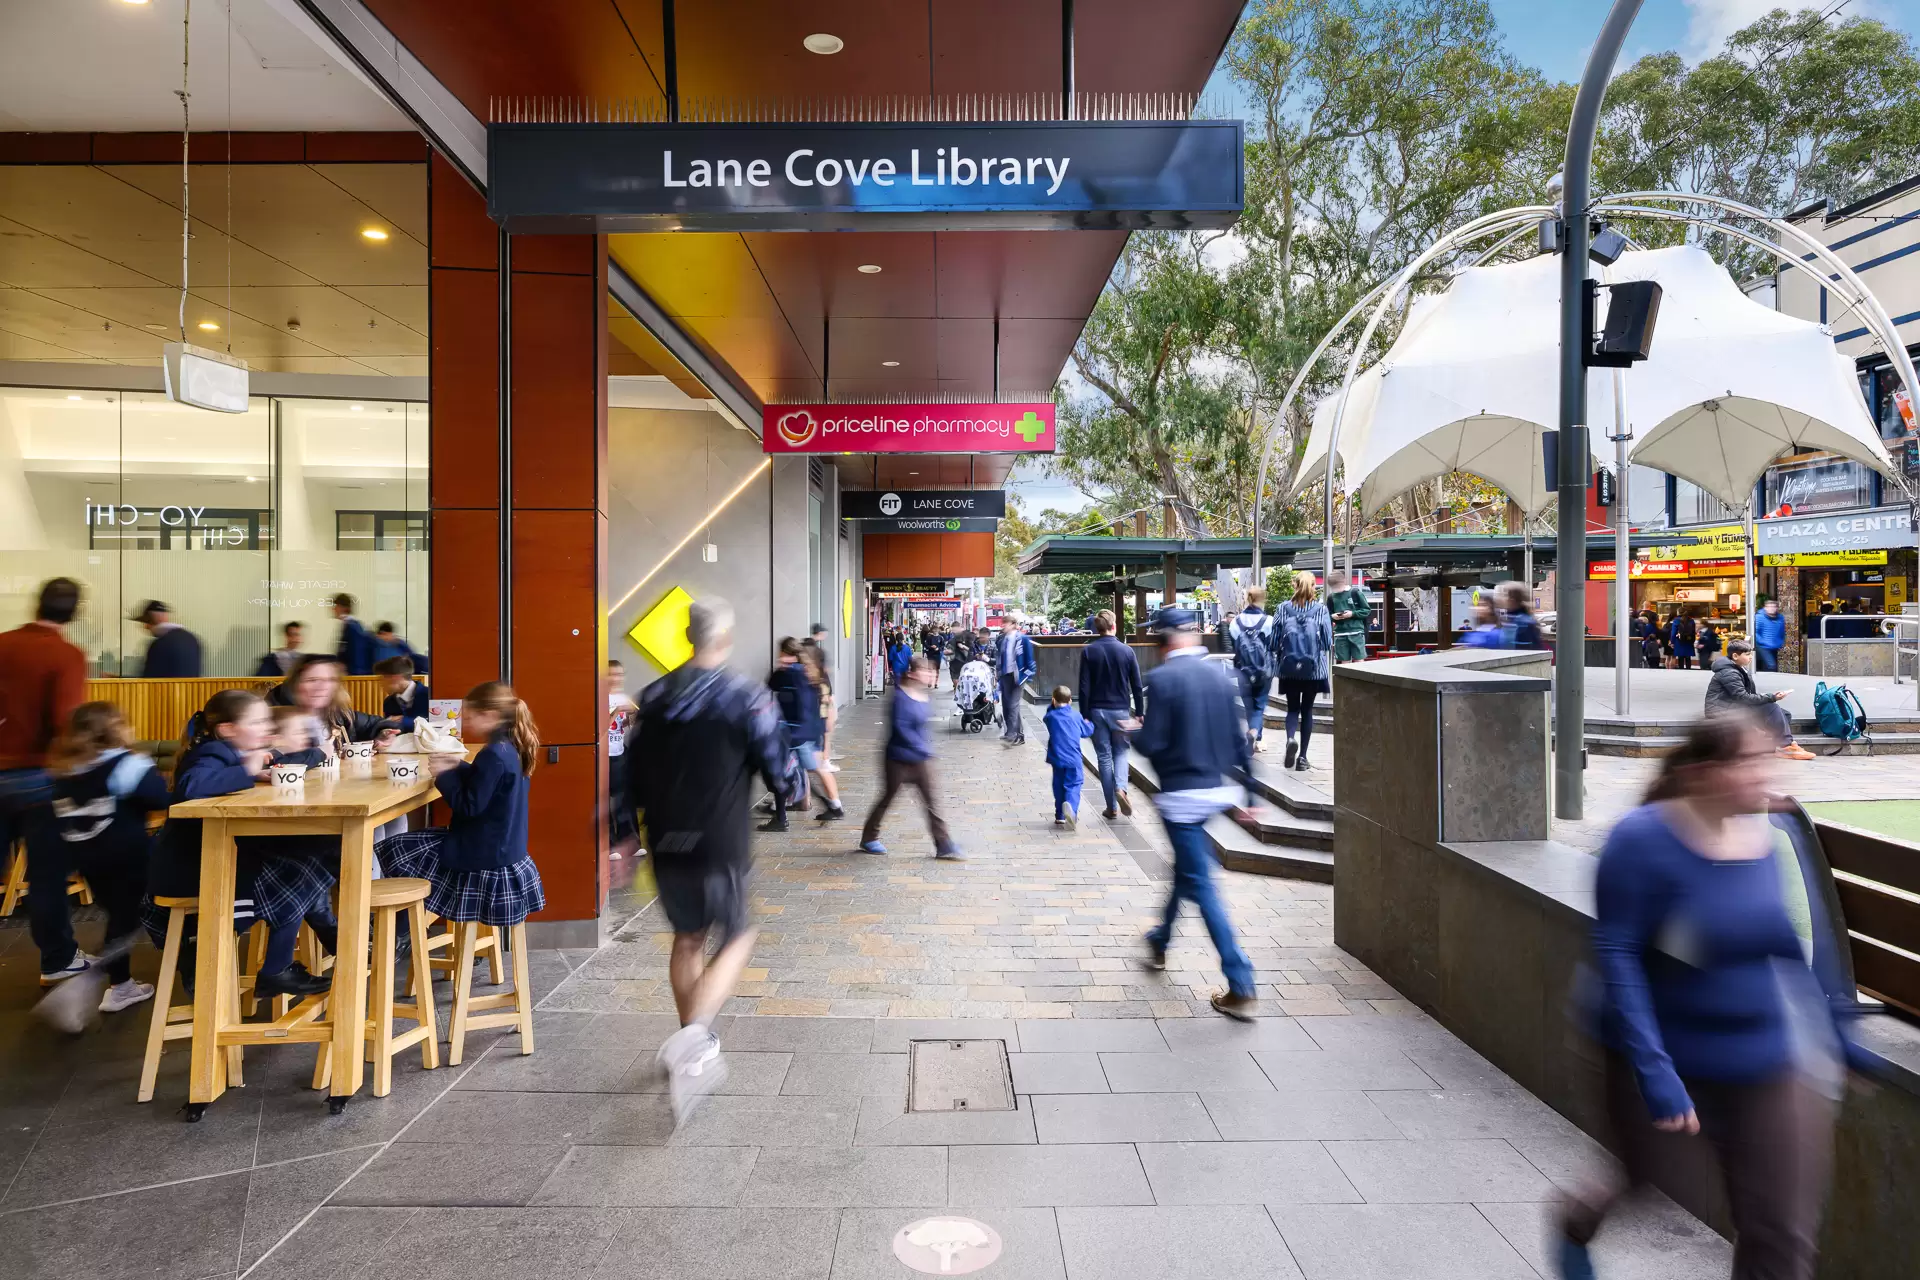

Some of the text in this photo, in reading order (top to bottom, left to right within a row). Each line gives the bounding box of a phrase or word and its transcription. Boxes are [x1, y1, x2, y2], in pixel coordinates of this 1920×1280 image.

[663, 147, 1071, 196] Lane Cove Library
[822, 416, 1010, 437] priceline pharmacy
[882, 499, 974, 509] FIT LANE COVE
[898, 519, 945, 529] Woolworths
[1767, 515, 1911, 538] PLAZA CENTR
[1715, 535, 1720, 545] Y
